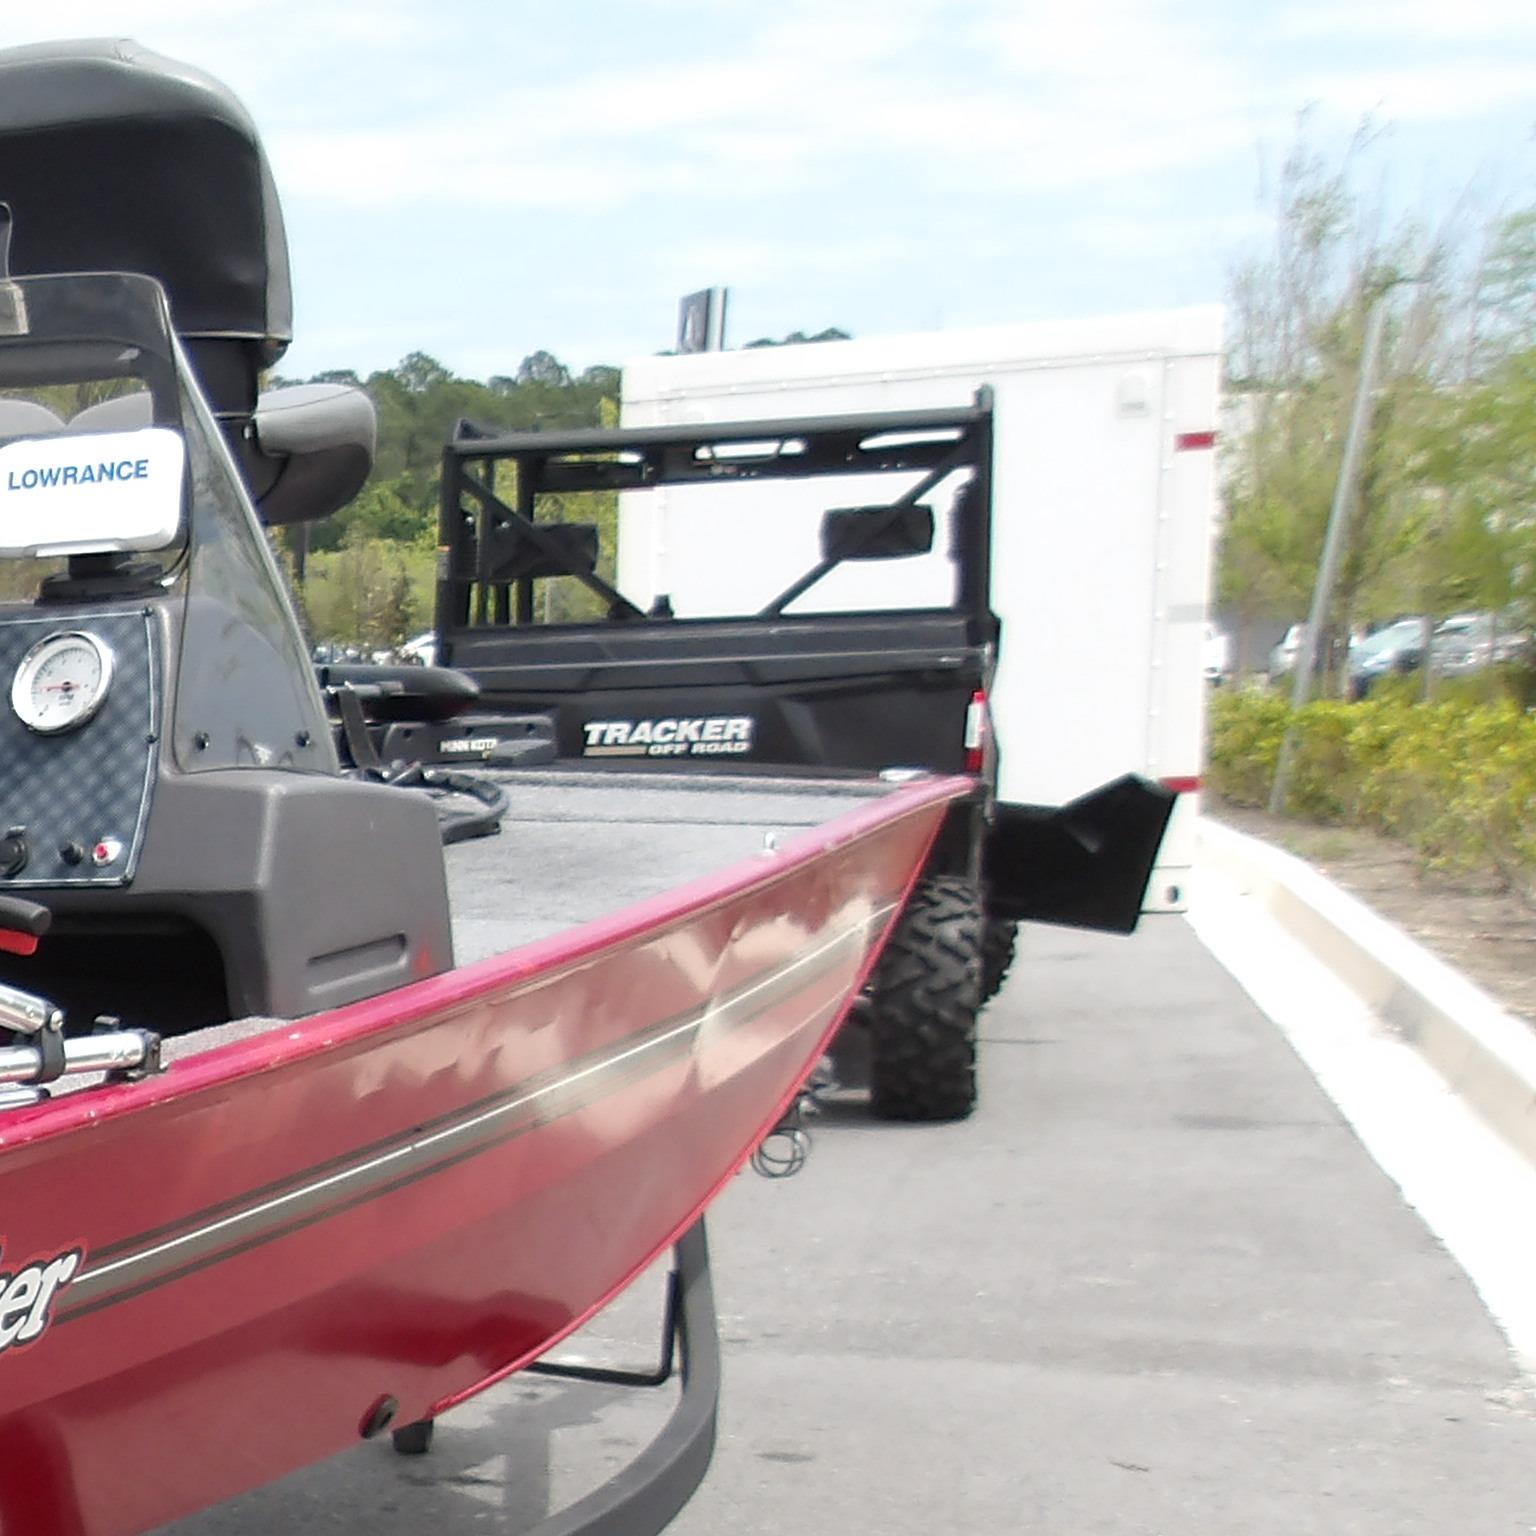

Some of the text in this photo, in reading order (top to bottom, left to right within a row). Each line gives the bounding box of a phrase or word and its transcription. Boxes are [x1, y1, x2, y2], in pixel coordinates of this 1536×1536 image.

[7, 459, 150, 491] LOWRANCE
[584, 718, 752, 745] TRACKER
[648, 740, 751, 756] OFF ROAD
